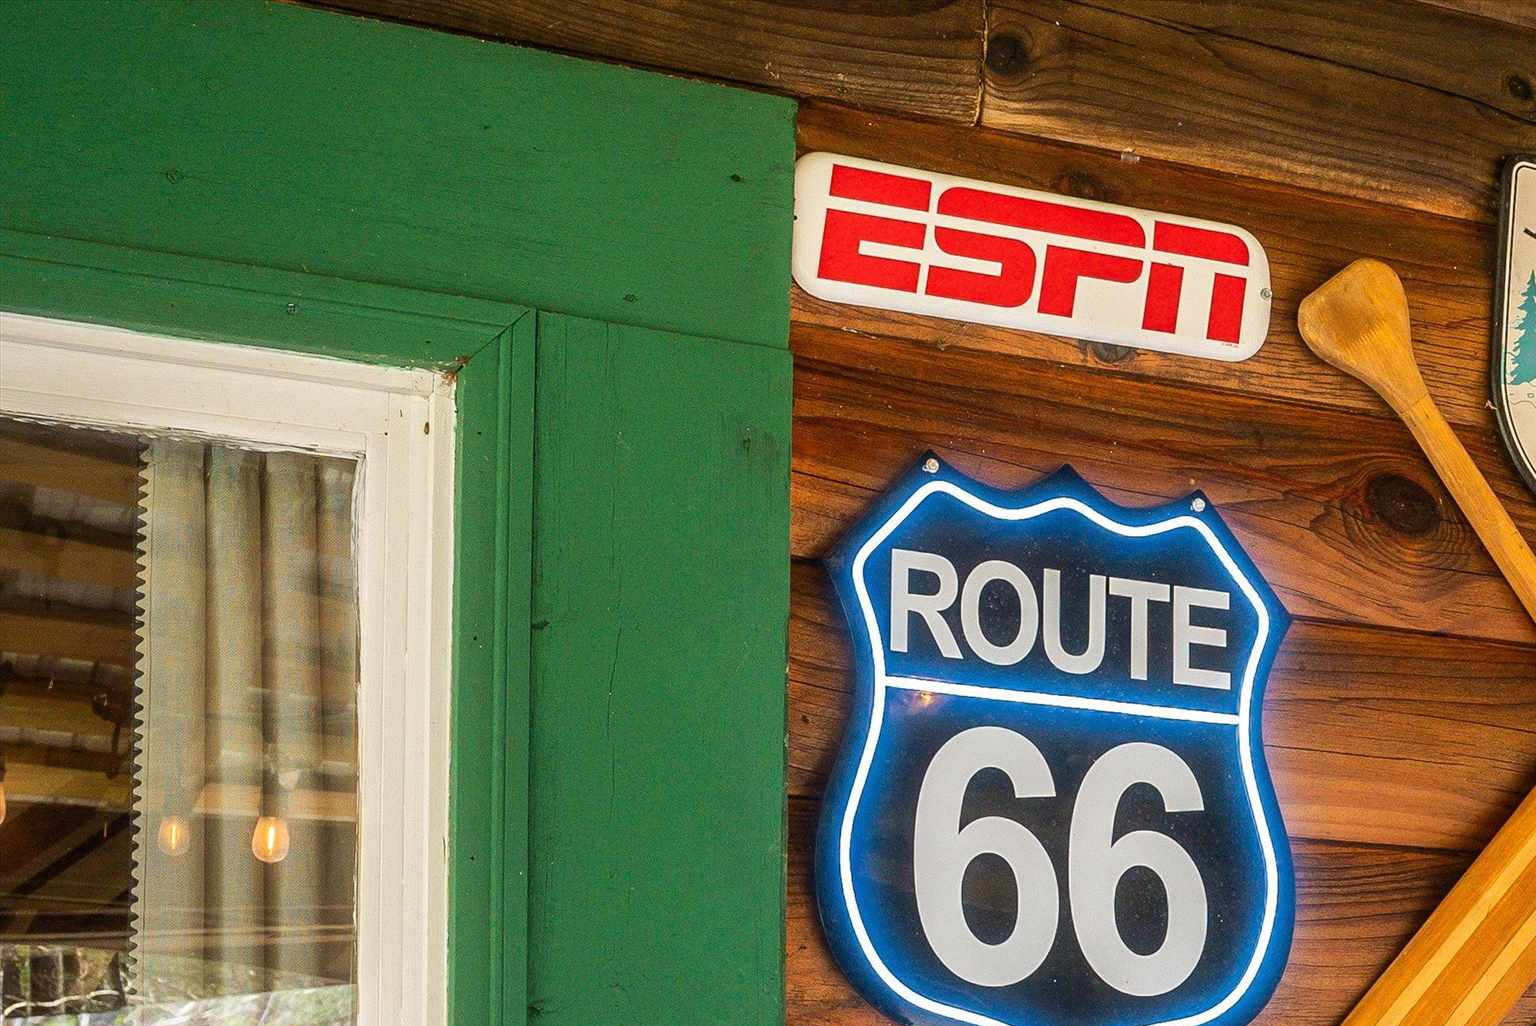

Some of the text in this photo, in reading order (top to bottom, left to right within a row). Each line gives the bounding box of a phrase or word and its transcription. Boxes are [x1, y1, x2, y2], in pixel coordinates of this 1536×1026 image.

[817, 164, 1250, 344] ESPN
[889, 548, 1232, 690] ROUTE
[912, 726, 1208, 997] 66
